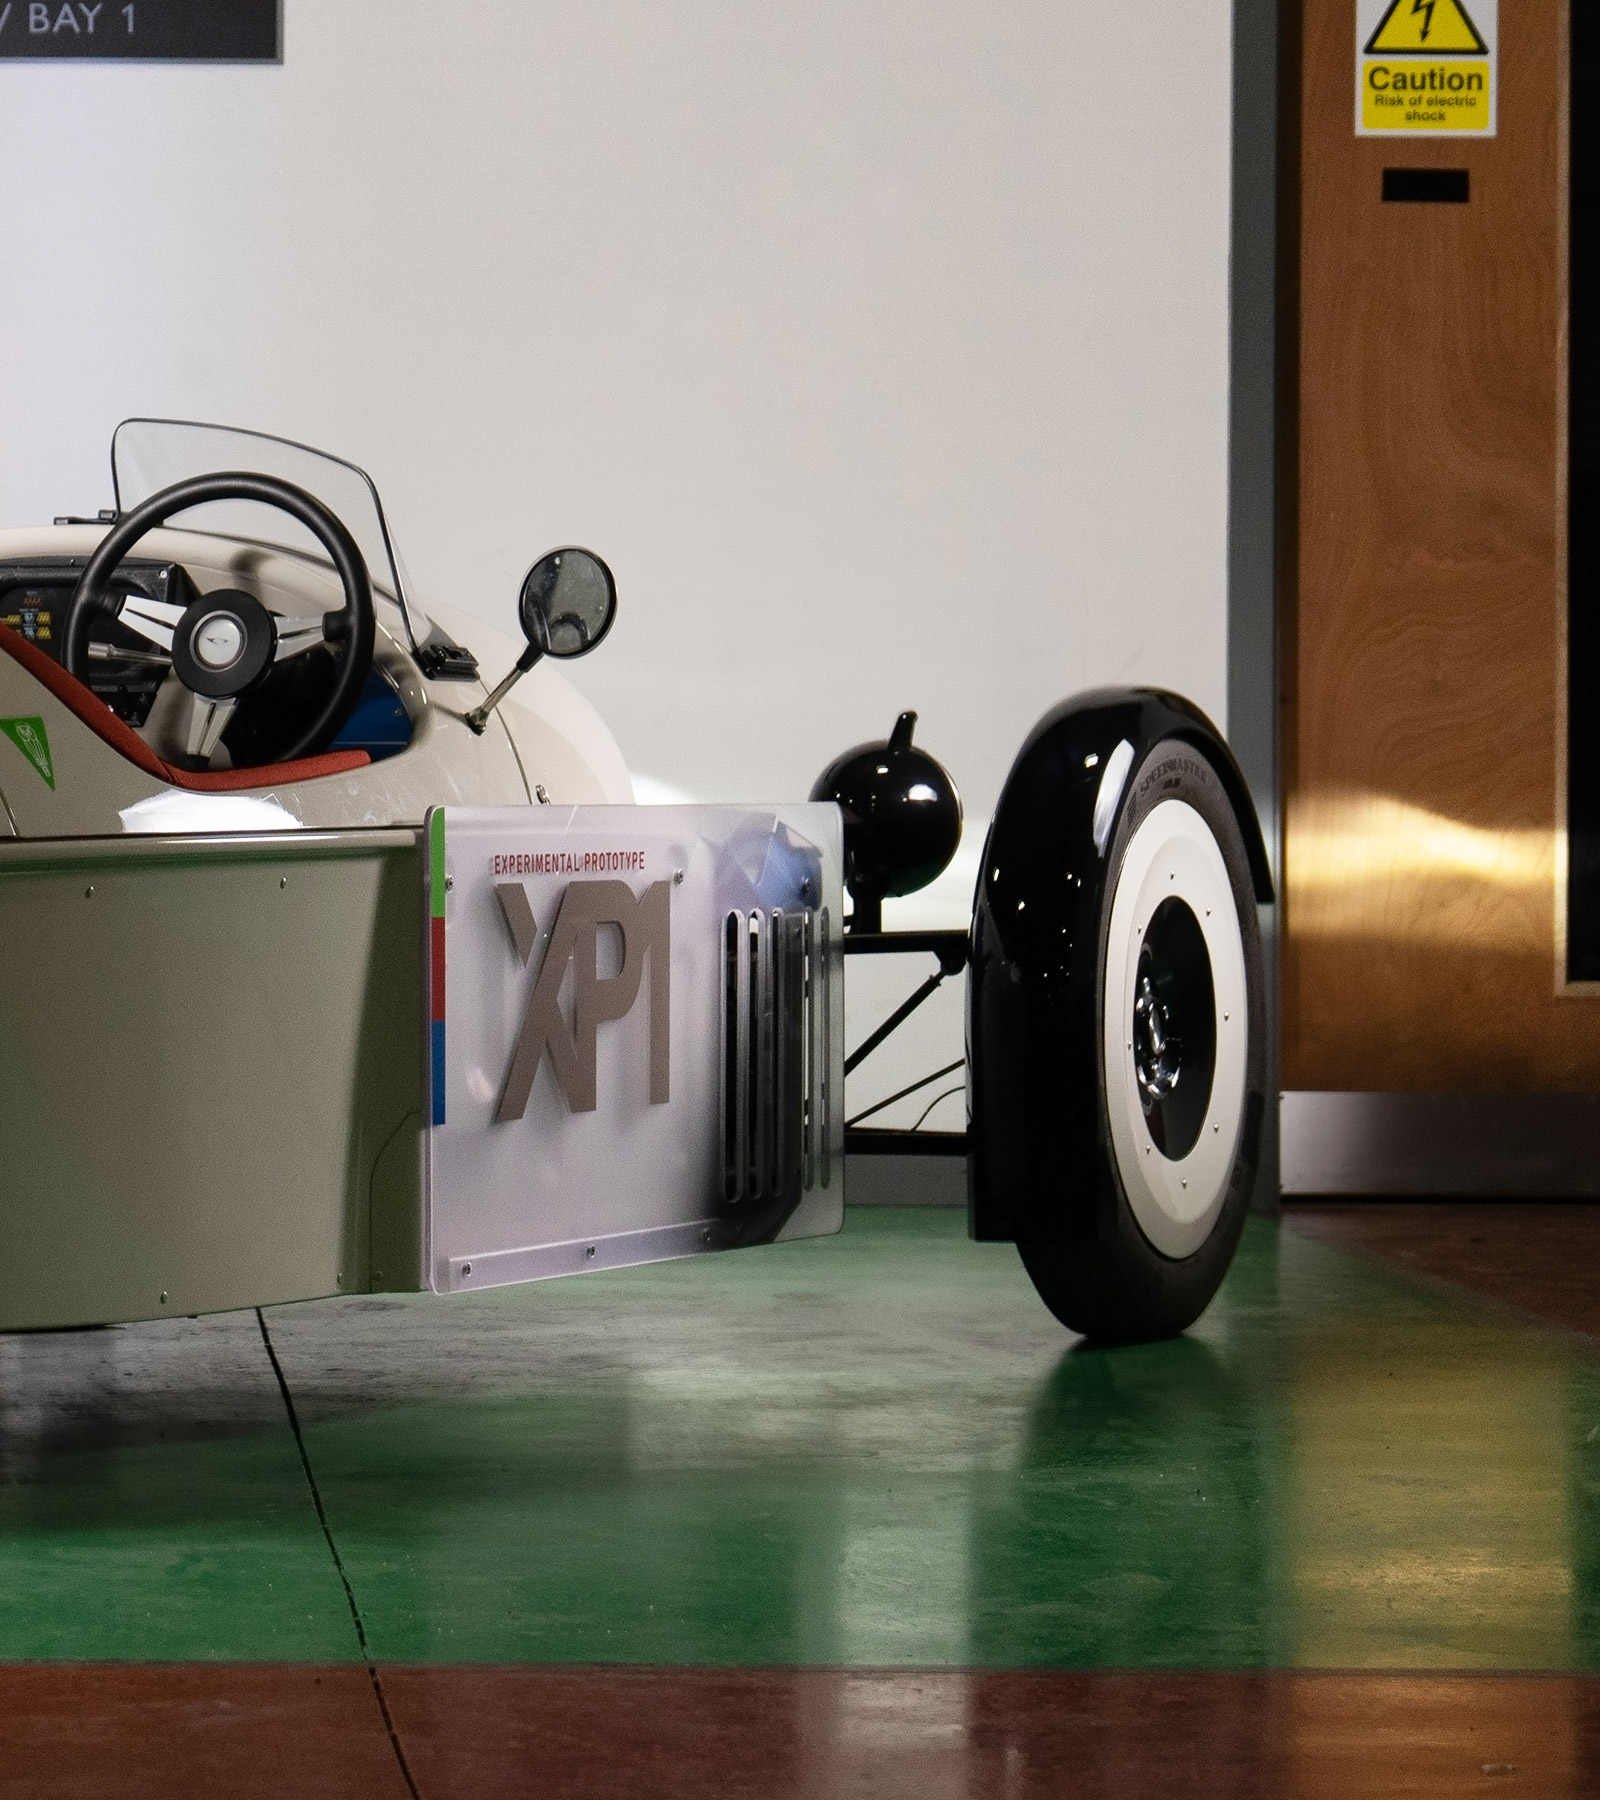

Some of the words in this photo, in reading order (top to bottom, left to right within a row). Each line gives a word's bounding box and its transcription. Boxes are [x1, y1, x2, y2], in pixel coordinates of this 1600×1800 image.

[29, 3, 103, 33] BAY
[121, 3, 135, 33] 1
[1368, 66, 1483, 91] Caution
[1374, 94, 1404, 106] Risk
[1409, 94, 1422, 106] of
[1426, 94, 1477, 107] electric
[1405, 109, 1445, 121] shock
[494, 853, 580, 875] EXPERIMENTAL
[584, 852, 645, 871] PROTOTYPE
[497, 879, 671, 1121] XP1
